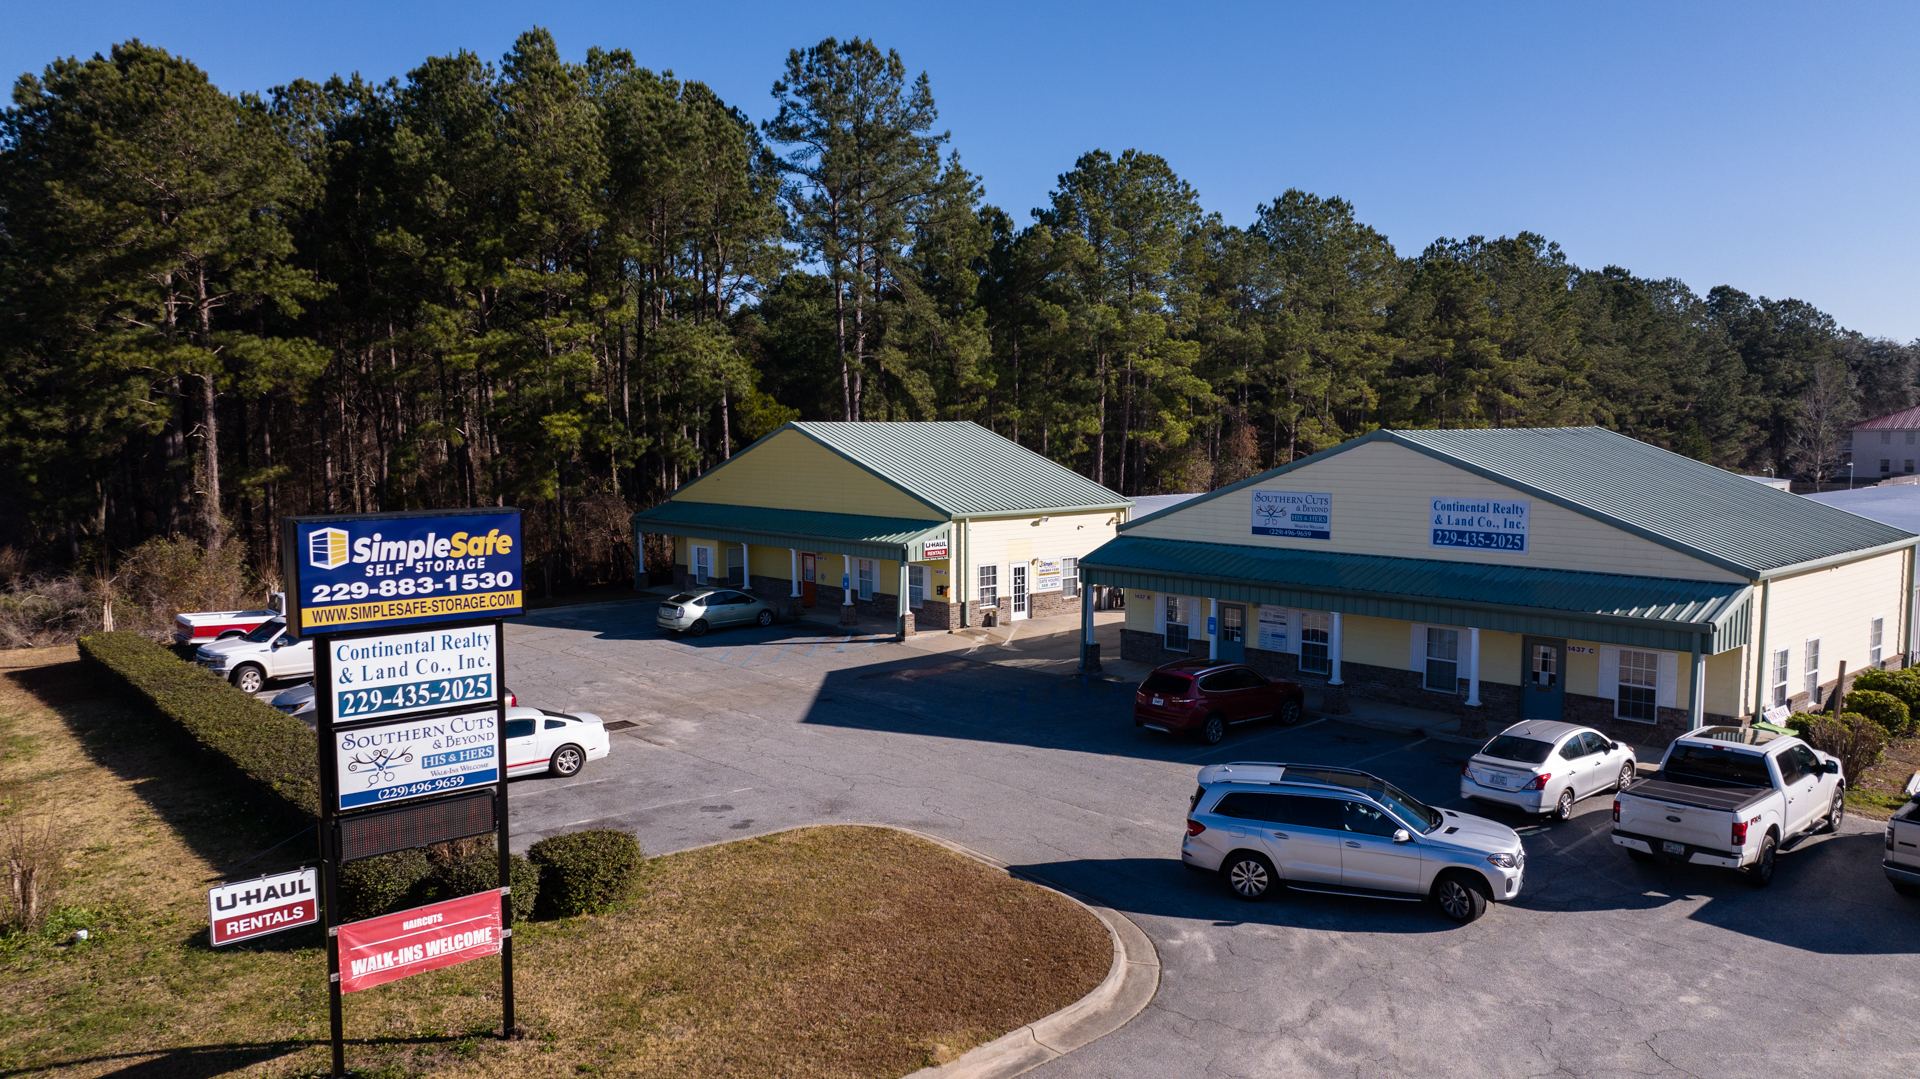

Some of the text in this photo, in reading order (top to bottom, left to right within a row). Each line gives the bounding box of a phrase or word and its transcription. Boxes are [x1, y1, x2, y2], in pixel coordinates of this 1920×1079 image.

[1305, 494, 1328, 505] CUTS
[1434, 500, 1525, 517] Continental Realty
[1435, 514, 1525, 530] & Land Co., Inc.
[352, 529, 513, 566] SimpleSafe
[1436, 530, 1521, 549] 229-435-2025
[365, 557, 486, 577] SELF STORAGE
[312, 571, 513, 602] 229-883-1530
[312, 594, 514, 623] WWW.SIMPLESAFE-STORAGE.COM
[337, 632, 491, 662] Continental Realty
[339, 654, 491, 684] & Land Co., Inc.
[343, 677, 488, 714] 229-435-2025
[342, 717, 494, 750] SOUTHERN CUTS
[433, 732, 494, 749] & BEYOND
[423, 747, 493, 768] HIS & HERS
[1750, 814, 1761, 826] FX4
[216, 879, 311, 911] U-HAUL
[226, 906, 304, 935] RENTALS
[403, 913, 443, 931] HAIRCUTS
[351, 927, 492, 976] WALK-INS WELCOME
